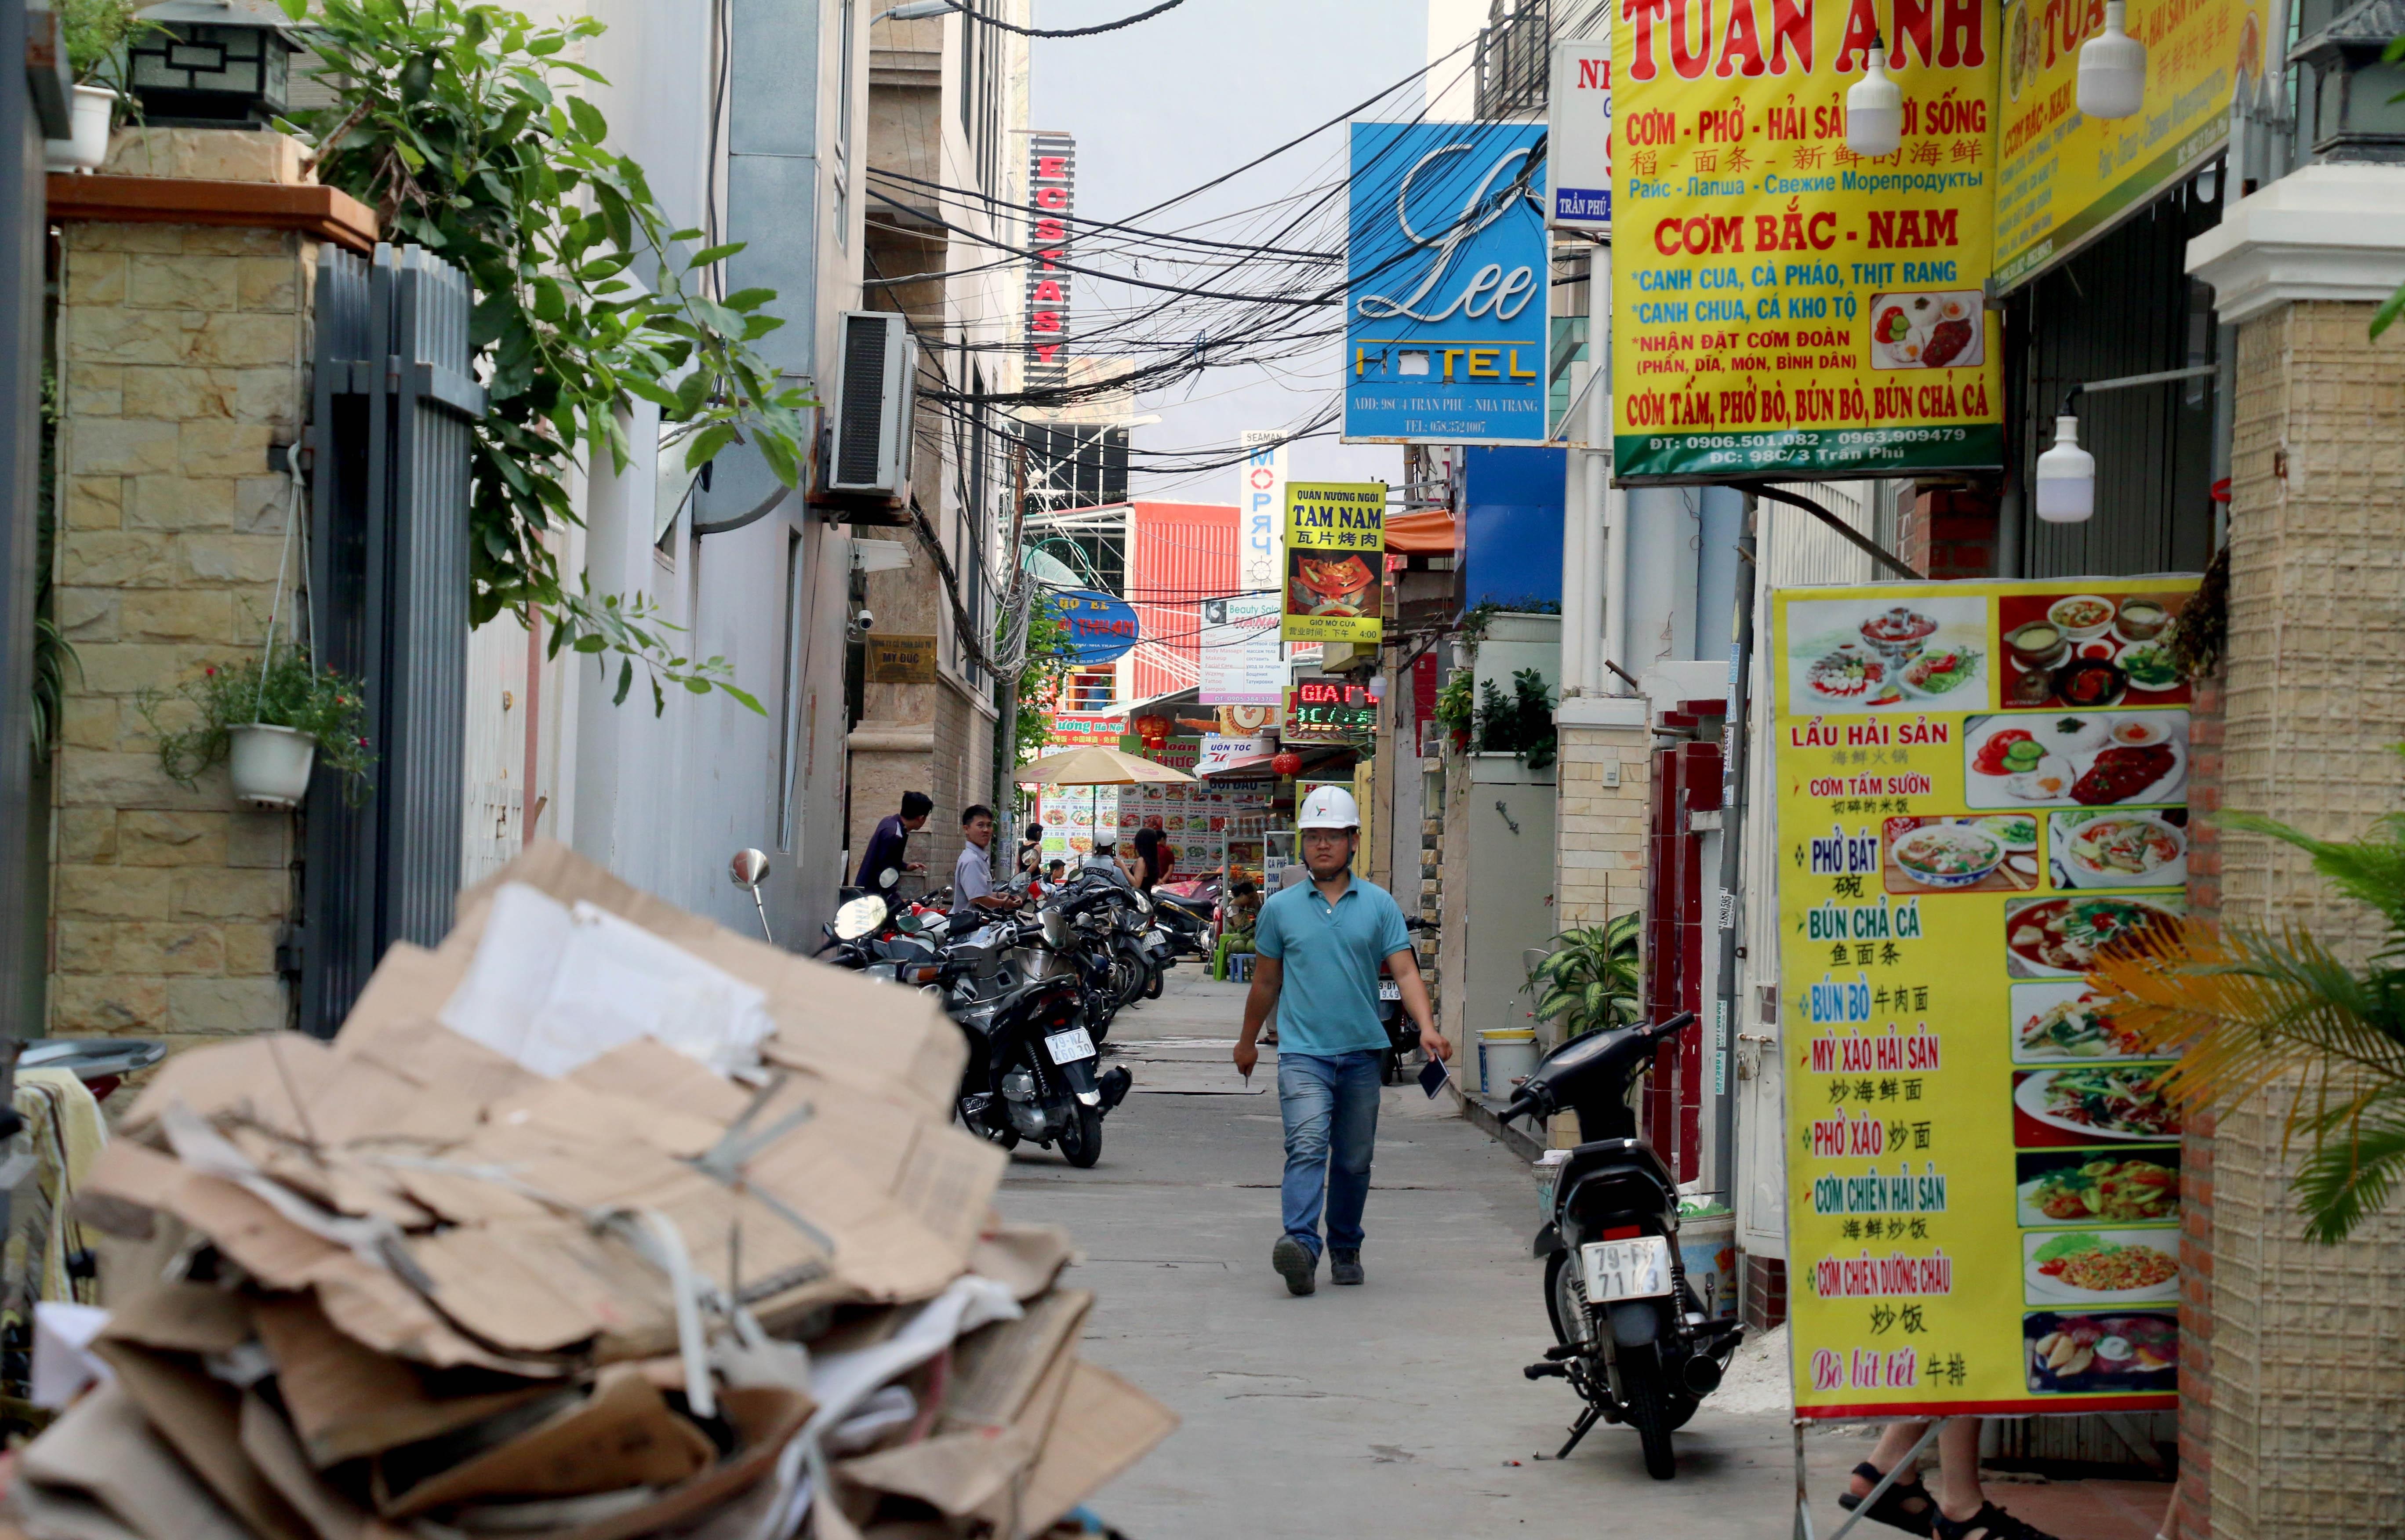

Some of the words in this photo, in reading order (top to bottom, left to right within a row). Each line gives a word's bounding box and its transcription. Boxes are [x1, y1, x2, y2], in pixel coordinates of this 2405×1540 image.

[1627, 107, 1675, 145] CƠM
[1699, 96, 1745, 143] PHỞ
[1768, 93, 1806, 140] HẢI
[1814, 92, 1848, 139] SẢ
[1925, 87, 1986, 134] SỐNG
[1629, 150, 1657, 175] 稻
[1693, 146, 1754, 173] 面条
[1629, 178, 1671, 198] Райс
[1686, 176, 1745, 196] Лапша
[1765, 174, 1835, 194] Свежие
[1842, 171, 1983, 194] Морепродукты
[1559, 192, 1585, 214] TRẦN
[1588, 196, 1606, 215] PHÚ
[1357, 144, 1537, 322] Lee
[1654, 213, 1744, 256] CƠM
[1755, 196, 1836, 251] BẮC
[1868, 209, 1958, 249] NAM
[1032, 156, 1068, 363] ECSTASY
[1700, 267, 1744, 291] CUA,
[1751, 259, 1777, 287] CÀ
[1785, 258, 1844, 289] PHÁO,
[1851, 262, 1896, 288] THỊT
[1904, 260, 1957, 283] RANG
[1695, 299, 1750, 324] CHUA,
[1757, 292, 1781, 320] CÁ
[1789, 296, 1827, 318] KHO
[1833, 291, 1857, 321] TỘ
[1701, 331, 1740, 353] ĐẶT
[1747, 330, 1790, 348] CƠM
[1797, 326, 1850, 348] ĐOÀN
[1356, 348, 1537, 378] HTEL
[1695, 354, 1726, 373] DĨA,
[1732, 353, 1771, 373] MÓN,
[1777, 352, 1813, 370] BÌNH
[1820, 352, 1856, 370] DÂN)
[1353, 397, 1379, 410] ADD:
[1381, 398, 1407, 410] 98C4
[1475, 399, 1497, 412] NHA
[1501, 399, 1538, 412] TRANG
[1627, 387, 1665, 426] CƠM
[1670, 375, 1715, 431] TẤM,
[1720, 375, 1757, 424] PHỞ
[1761, 379, 1791, 429] BÒ,
[1795, 378, 1834, 421] BÚN
[1839, 378, 1870, 427] BÒ,
[1873, 377, 1913, 419] BÚN
[1918, 370, 1958, 418] CHẢ
[1962, 373, 1989, 417] CÁ
[1247, 432, 1282, 442] SEAMAN
[1405, 419, 1428, 432] TEL:
[1686, 433, 1819, 450] 0906.501.082
[1869, 447, 1904, 460] Phú
[1293, 505, 1333, 527] TAM
[1339, 507, 1382, 529] NAM
[1296, 530, 1377, 547] 瓦片烤肉
[1230, 604, 1258, 616] Beauty
[1261, 605, 1281, 614] Salo
[1301, 684, 1339, 702] GIA
[1056, 719, 1090, 733] ương
[1791, 716, 1838, 746] LẨU
[1848, 717, 1889, 745] HẢI
[1898, 716, 1947, 744] SẢN
[1211, 741, 1230, 751] UỐN
[1831, 749, 1909, 766] 海鲜火锅
[1810, 777, 1843, 795] CƠM
[1849, 771, 1882, 795] TẤM
[1889, 772, 1930, 794] SƯỜN
[1831, 798, 1910, 814] 切碎的米饭
[1813, 826, 1843, 872] PHỞ
[1849, 830, 1877, 871] BÁT
[1268, 873, 1279, 883] SINH
[1833, 873, 1864, 900] 碗
[1810, 901, 1847, 939] BÚN
[1853, 896, 1889, 937] CHẢ
[1896, 899, 1920, 937] CÁ
[1830, 940, 1902, 966] 鱼面条
[1812, 974, 1843, 1022] BÚN
[1848, 972, 1870, 1022] BÒ
[1874, 984, 1929, 1014] 牛肉面
[1813, 1030, 1836, 1071] MỲ
[1842, 1028, 1873, 1071] XÀO
[1877, 1024, 1903, 1070] HẢI
[1908, 1023, 1939, 1069] SẢN
[1828, 1077, 1923, 1104] 炒海鲜面
[1815, 1108, 1846, 1156] PHỞ
[1851, 1111, 1882, 1156] XÀO
[1888, 1119, 1931, 1153] 炒面
[1816, 1173, 1843, 1212] CƠM
[1848, 1168, 1888, 1212] CHIÊN
[1892, 1163, 1914, 1210] HẢI
[1918, 1162, 1945, 1210] SẢN
[1842, 1216, 1929, 1241] 海鲜炒饭
[1818, 1256, 1841, 1297] CƠM
[1844, 1250, 1878, 1295] CHIÊN
[1919, 1248, 1951, 1294] CHÂU
[1870, 1303, 1928, 1335] 炒饭
[1812, 1349, 1843, 1390] Bò
[1887, 1348, 1916, 1387] tết
[1925, 1352, 1967, 1387] 牛排
